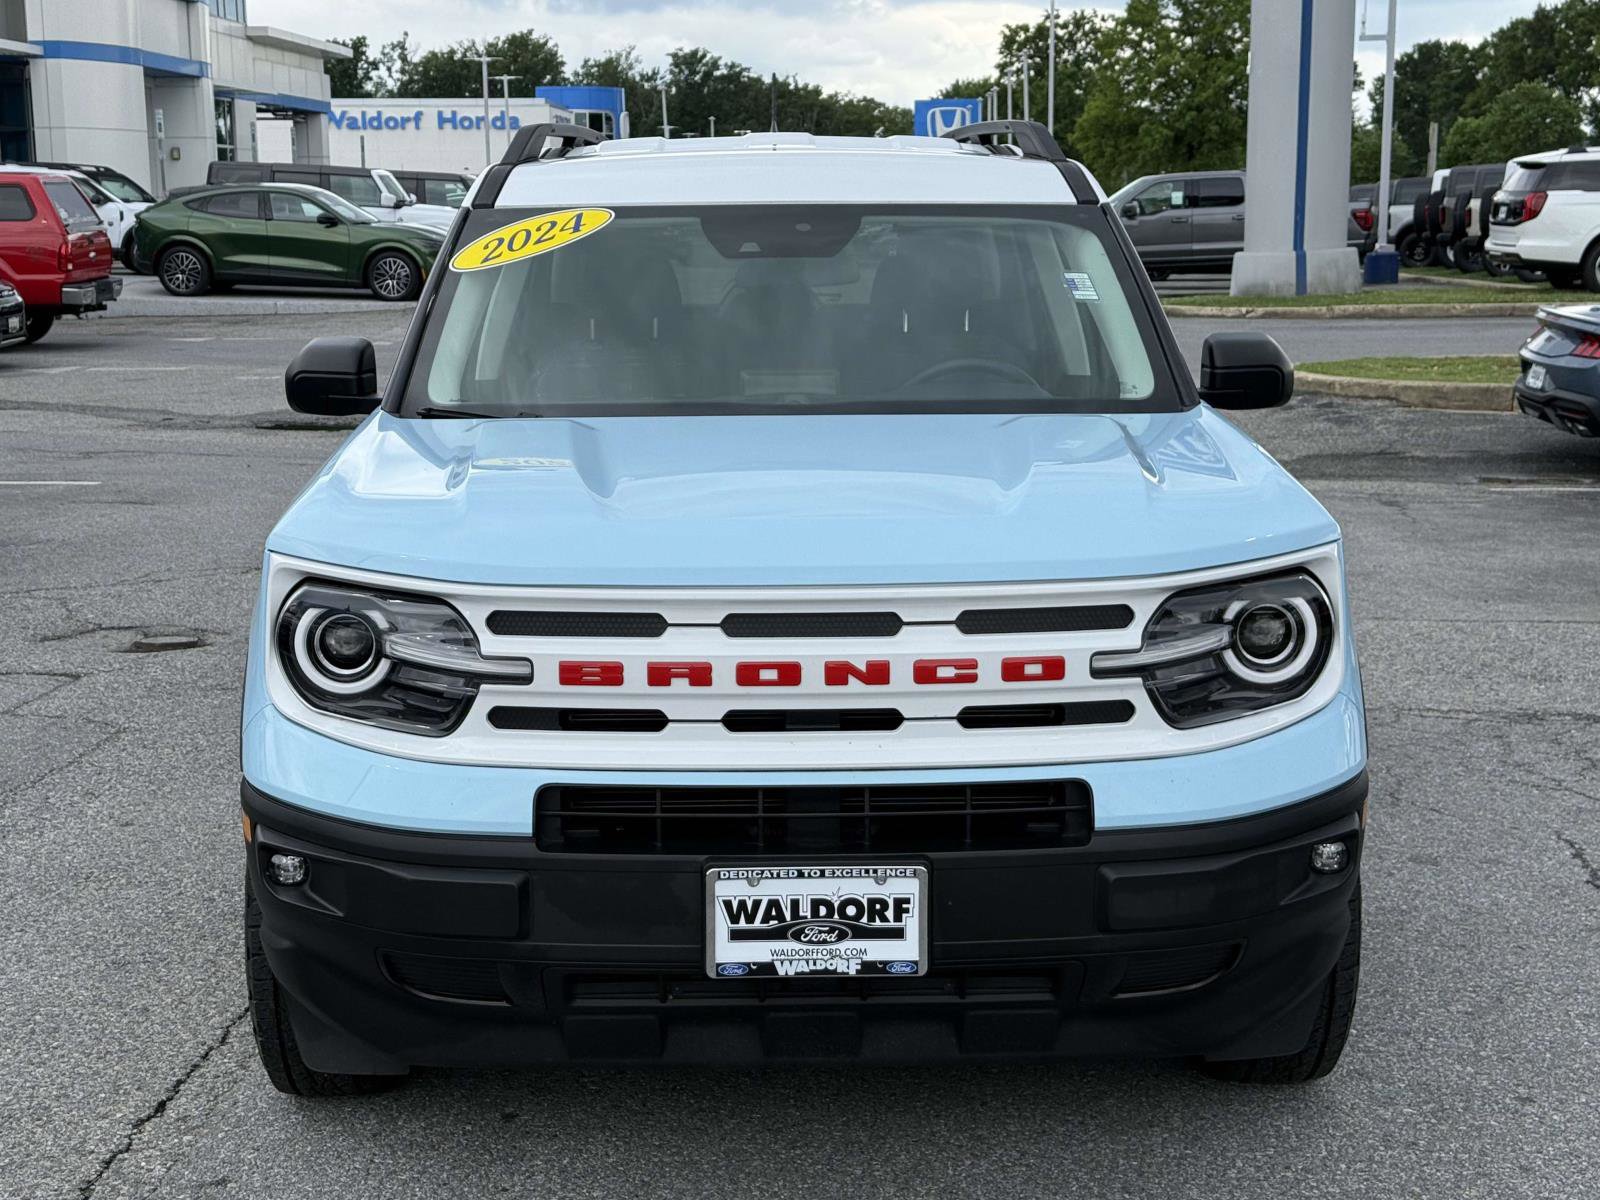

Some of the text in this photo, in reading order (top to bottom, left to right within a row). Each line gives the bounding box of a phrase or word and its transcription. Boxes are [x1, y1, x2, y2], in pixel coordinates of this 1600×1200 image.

[437, 110, 521, 130] Honda
[480, 211, 587, 265] 2024
[558, 655, 1066, 687] BRONCO
[720, 868, 915, 879] DEDICATED TO EXCELLENCE
[719, 895, 914, 925] WALDORF
[800, 925, 839, 942] Ford
[769, 947, 868, 958] WALDORFFORD.COM
[773, 958, 862, 976] WALDORF
